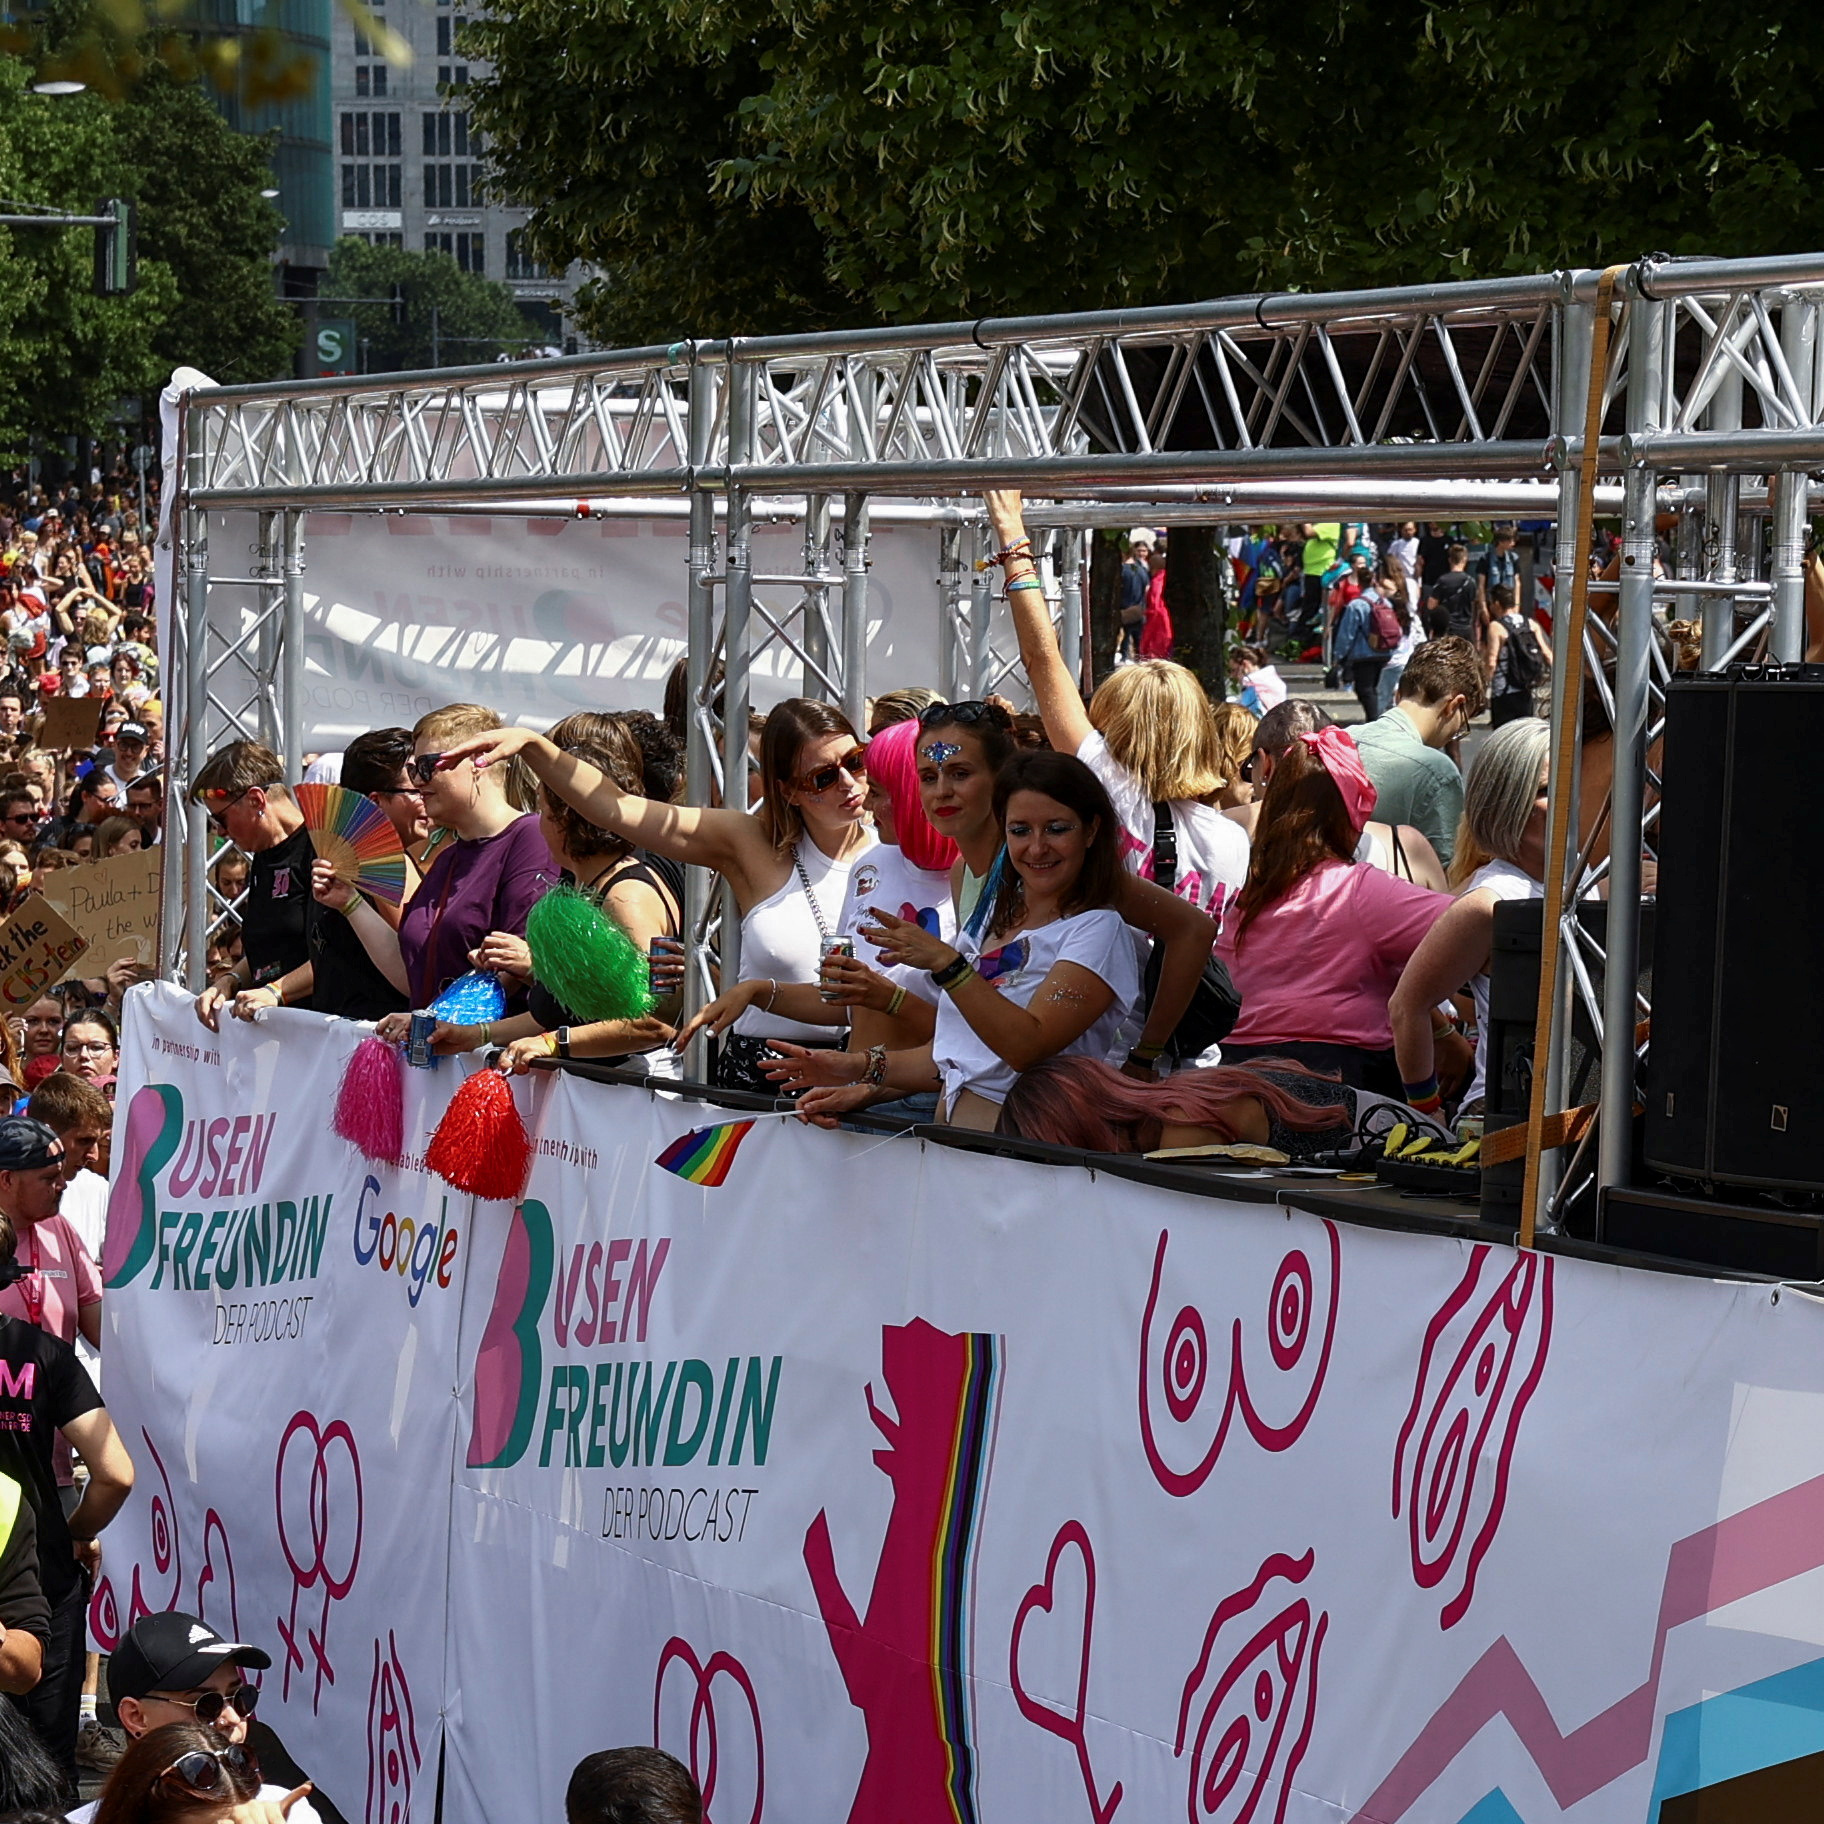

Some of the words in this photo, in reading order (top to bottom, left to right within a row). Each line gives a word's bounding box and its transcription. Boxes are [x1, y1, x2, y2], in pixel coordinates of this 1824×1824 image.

[8, 920, 48, 952] the
[107, 916, 133, 940] the
[151, 1036, 160, 1050] in
[162, 1041, 200, 1064] partnership
[203, 1048, 221, 1066] with
[149, 1194, 334, 1292] FREUNDIN
[352, 1174, 458, 1309] Google
[213, 1303, 248, 1345] DER
[249, 1296, 314, 1342] PODCAST
[537, 1354, 783, 1469] FREUNDIN
[602, 1487, 634, 1540] DER
[637, 1487, 760, 1543] PODCAST
